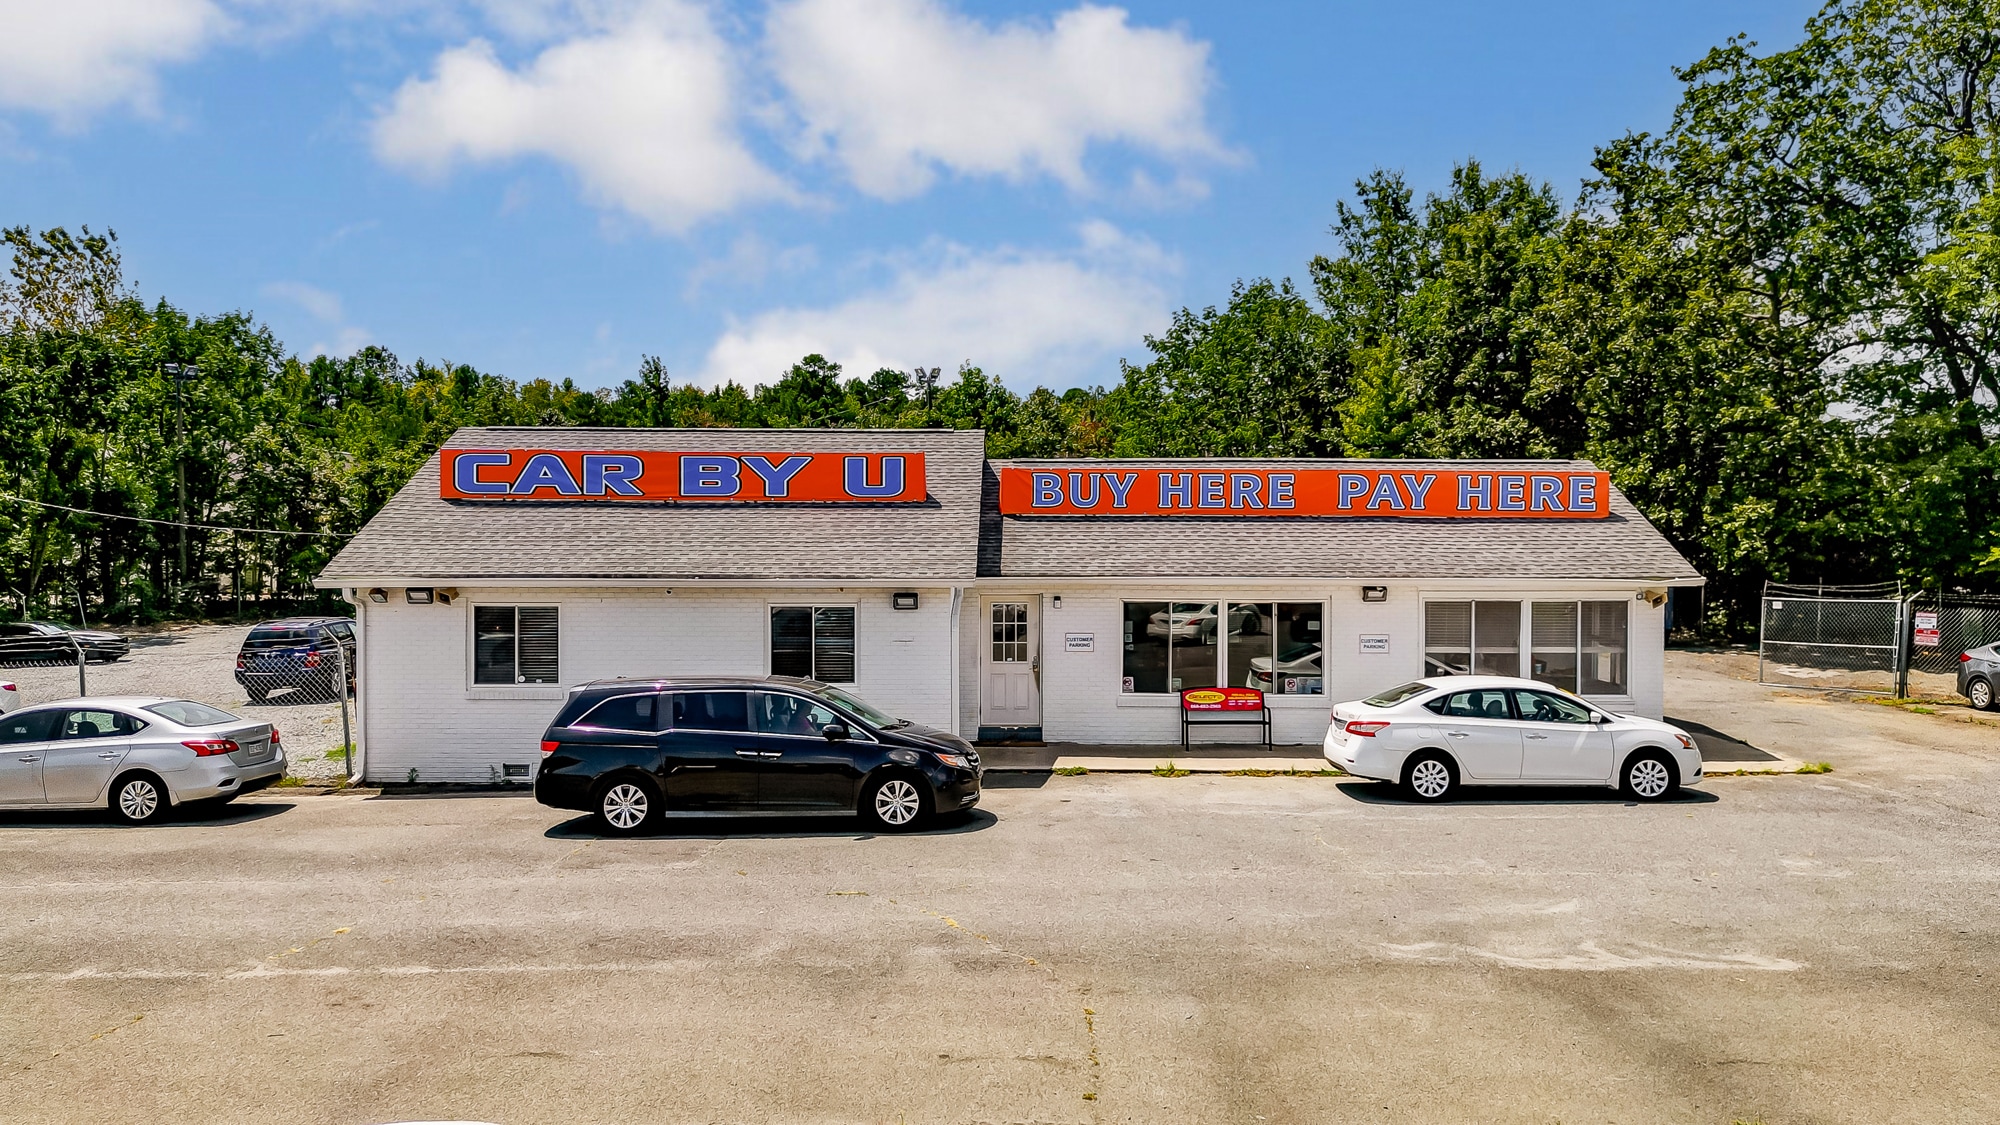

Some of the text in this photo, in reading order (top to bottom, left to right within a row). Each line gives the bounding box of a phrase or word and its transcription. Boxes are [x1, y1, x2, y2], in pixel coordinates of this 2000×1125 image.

[453, 452, 905, 498] CAR BY U
[1031, 471, 1597, 512] BUY HERE PAY HERE
